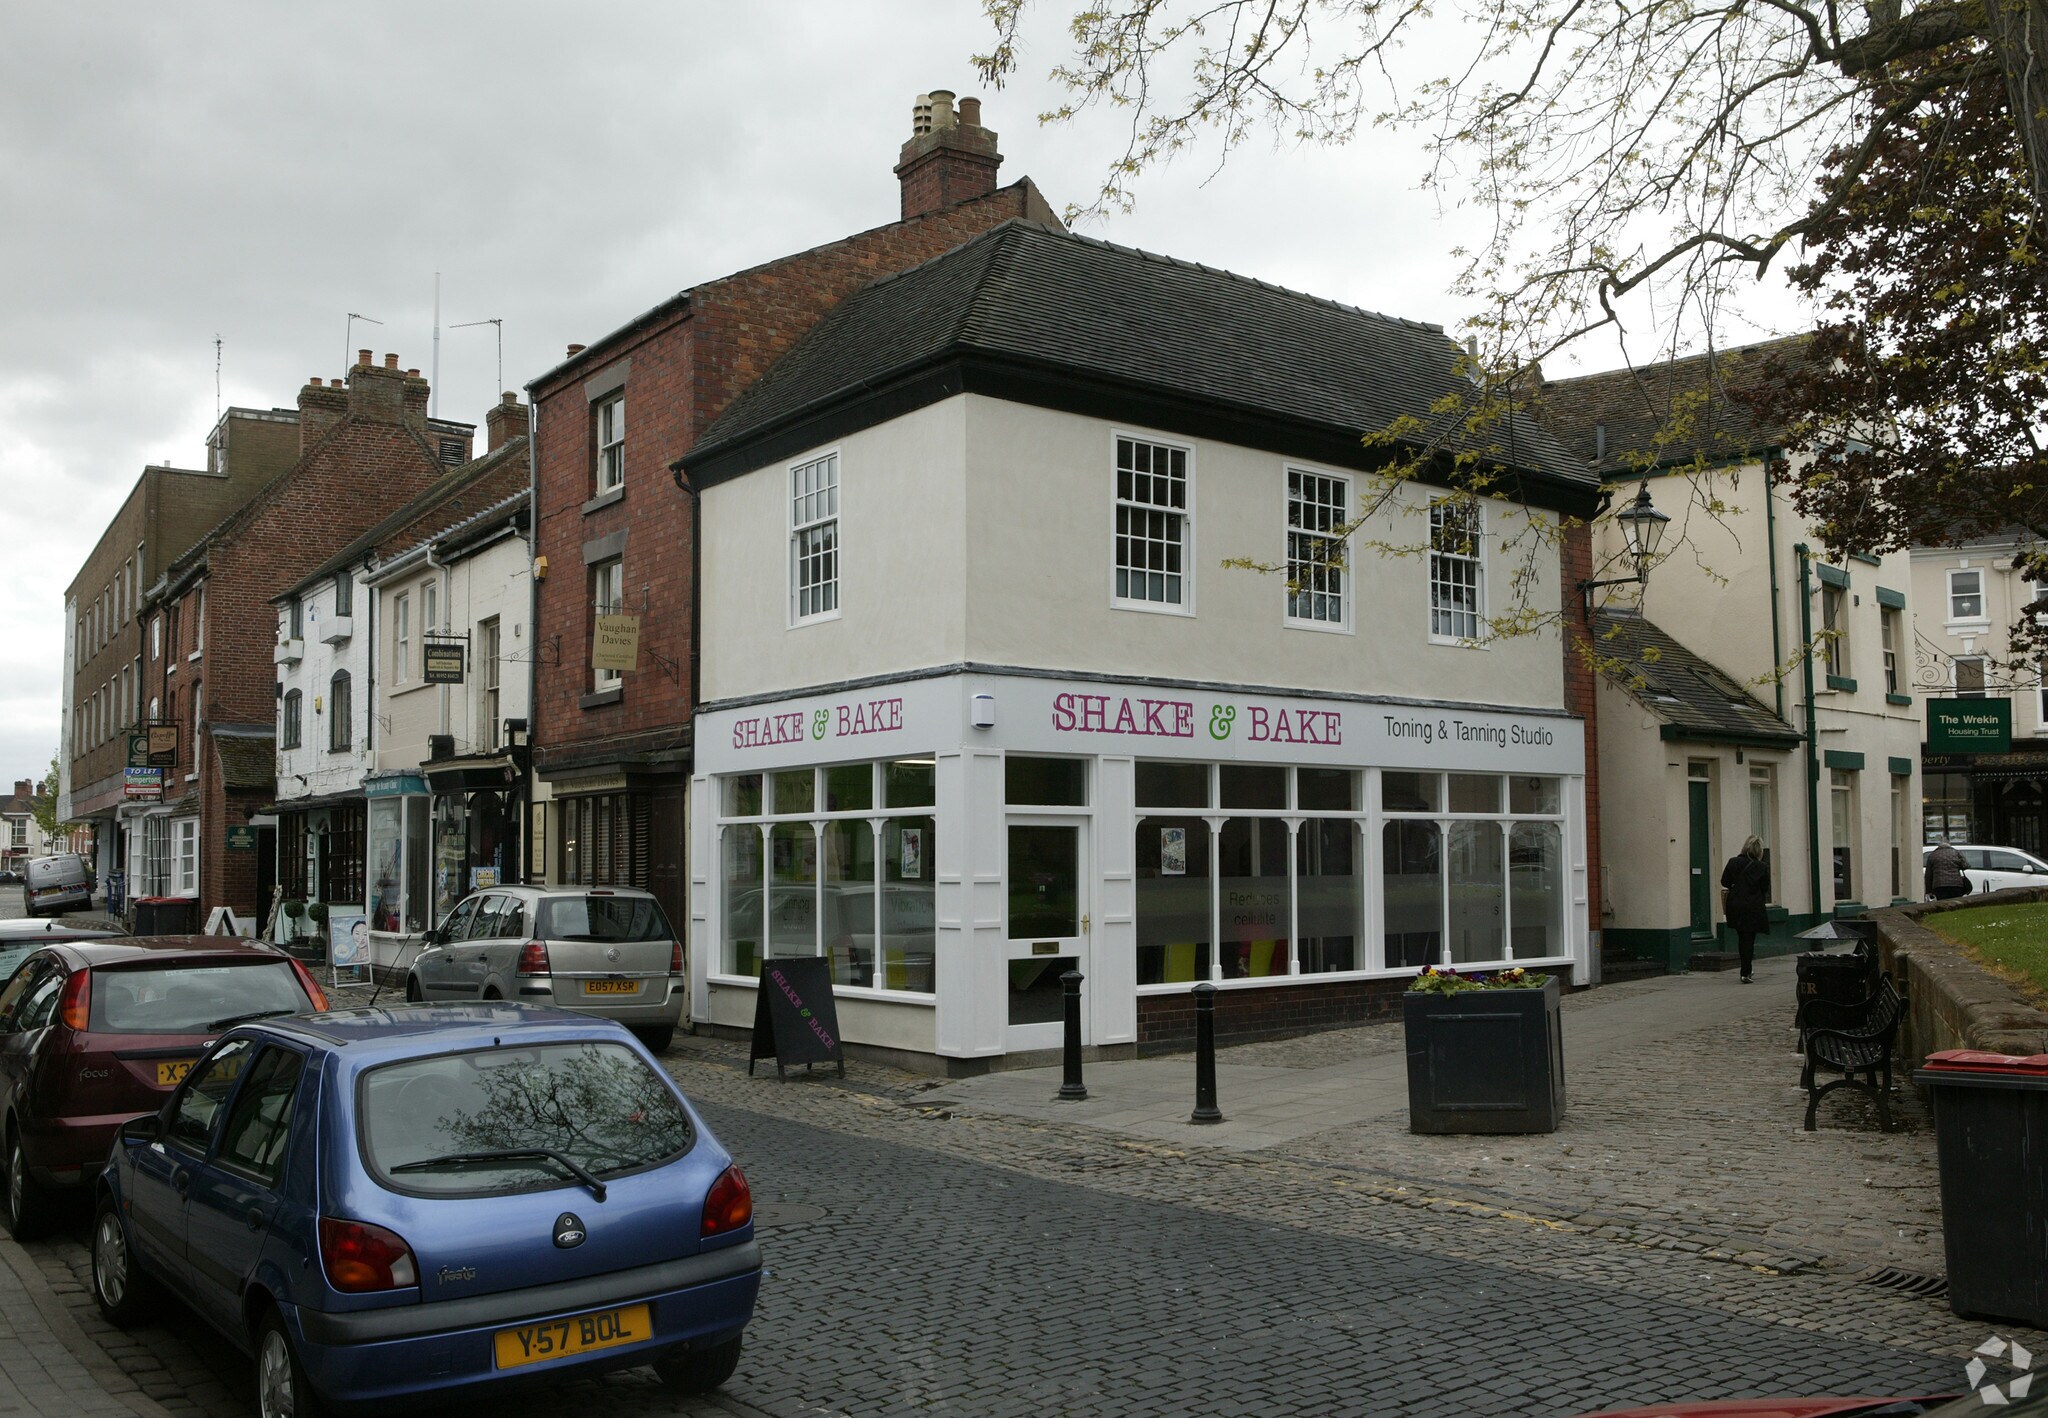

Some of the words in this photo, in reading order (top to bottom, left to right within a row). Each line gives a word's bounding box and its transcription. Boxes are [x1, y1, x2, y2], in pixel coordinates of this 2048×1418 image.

[598, 622, 637, 635] Vaughan
[602, 635, 632, 646] Davies
[733, 712, 803, 750] SHAKE
[812, 709, 829, 741] &
[836, 698, 902, 737] BAKE
[1053, 692, 1194, 738] SHAKE
[1209, 704, 1236, 741] &
[1247, 706, 1341, 745] BAKE
[1939, 715, 1959, 724] The
[1963, 715, 1999, 724] Wrekin
[1384, 716, 1432, 744] Toning
[1437, 719, 1448, 740] &
[1453, 720, 1506, 748] Tanning
[1511, 724, 1553, 746] Studio
[1948, 728, 1979, 736] Housing
[127, 775, 161, 785] Tempertons
[1230, 891, 1280, 906] Reduces
[1234, 911, 1276, 926] cellulite
[616, 981, 635, 992] XSR
[771, 970, 802, 1008] SHAKE
[800, 1008, 811, 1017] &
[808, 1017, 835, 1049] BAKE
[79, 1066, 109, 1082] Focus
[517, 1323, 570, 1357] Y57
[579, 1312, 632, 1345] BOL
